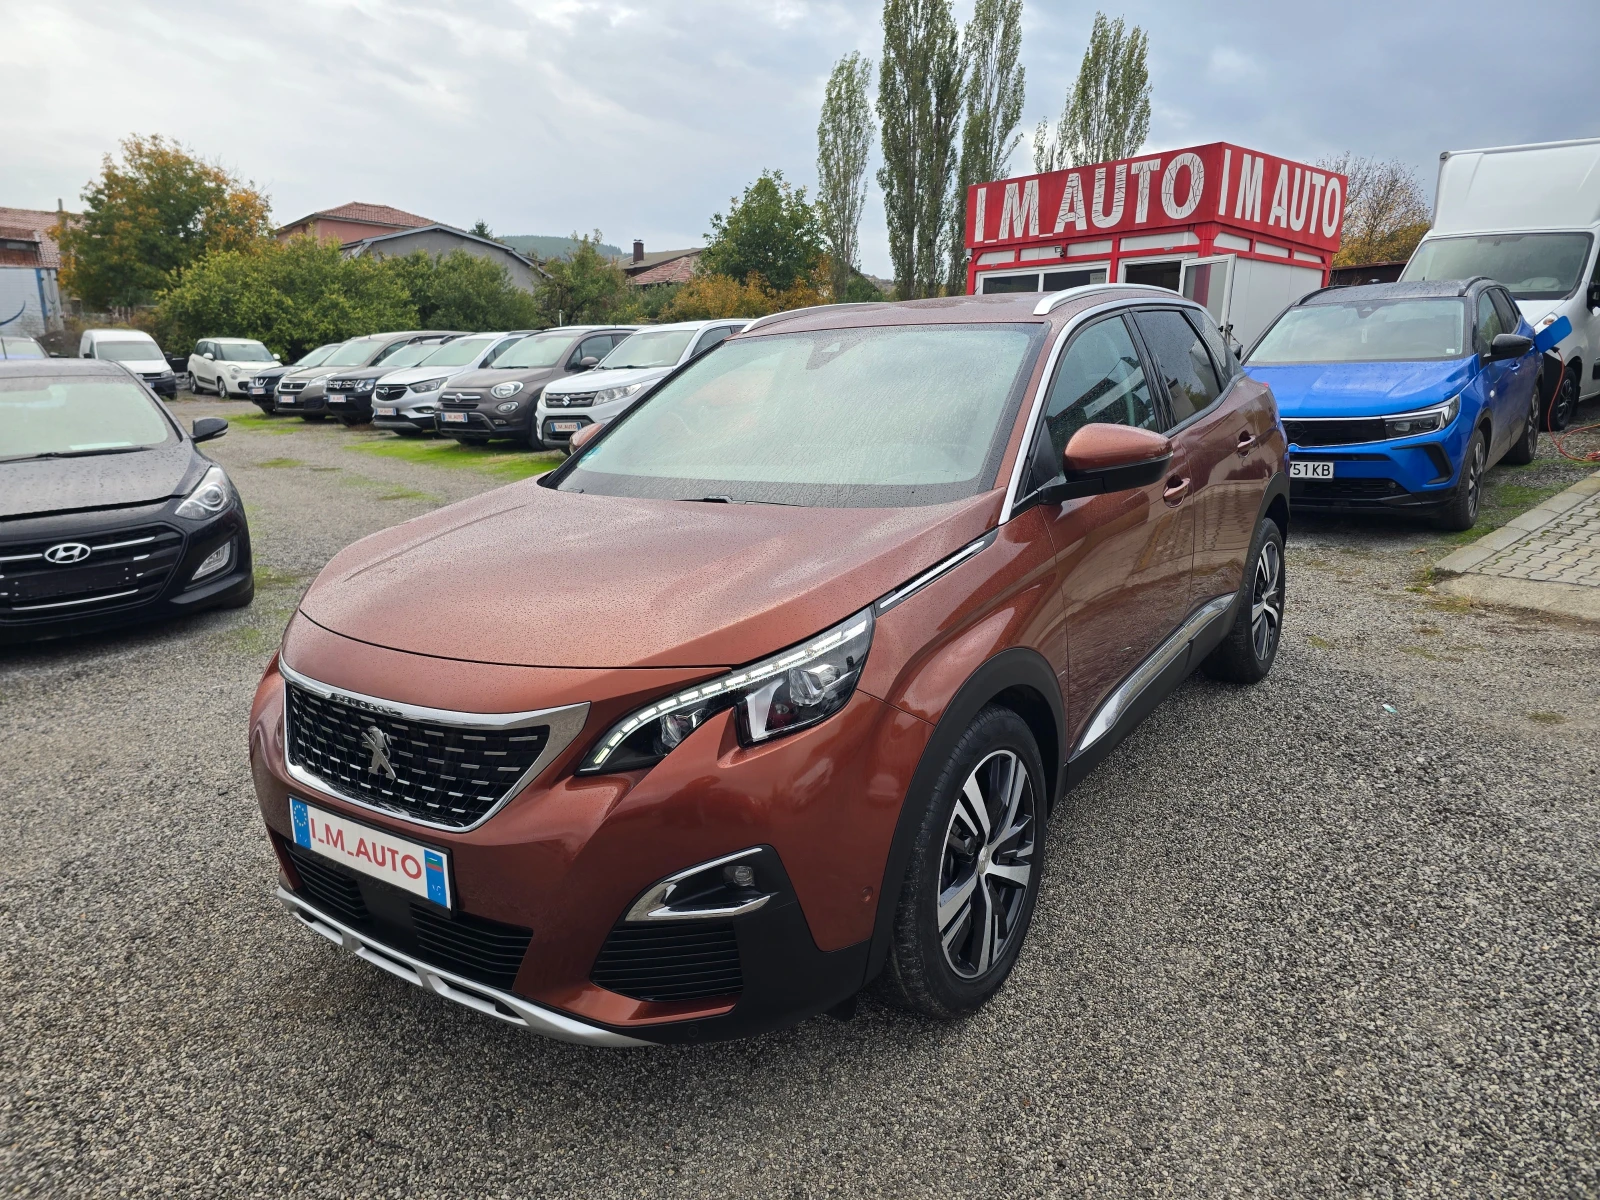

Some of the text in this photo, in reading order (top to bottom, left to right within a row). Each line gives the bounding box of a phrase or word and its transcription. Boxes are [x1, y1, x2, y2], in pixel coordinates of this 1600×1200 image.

[1218, 148, 1341, 239] I M AUTO
